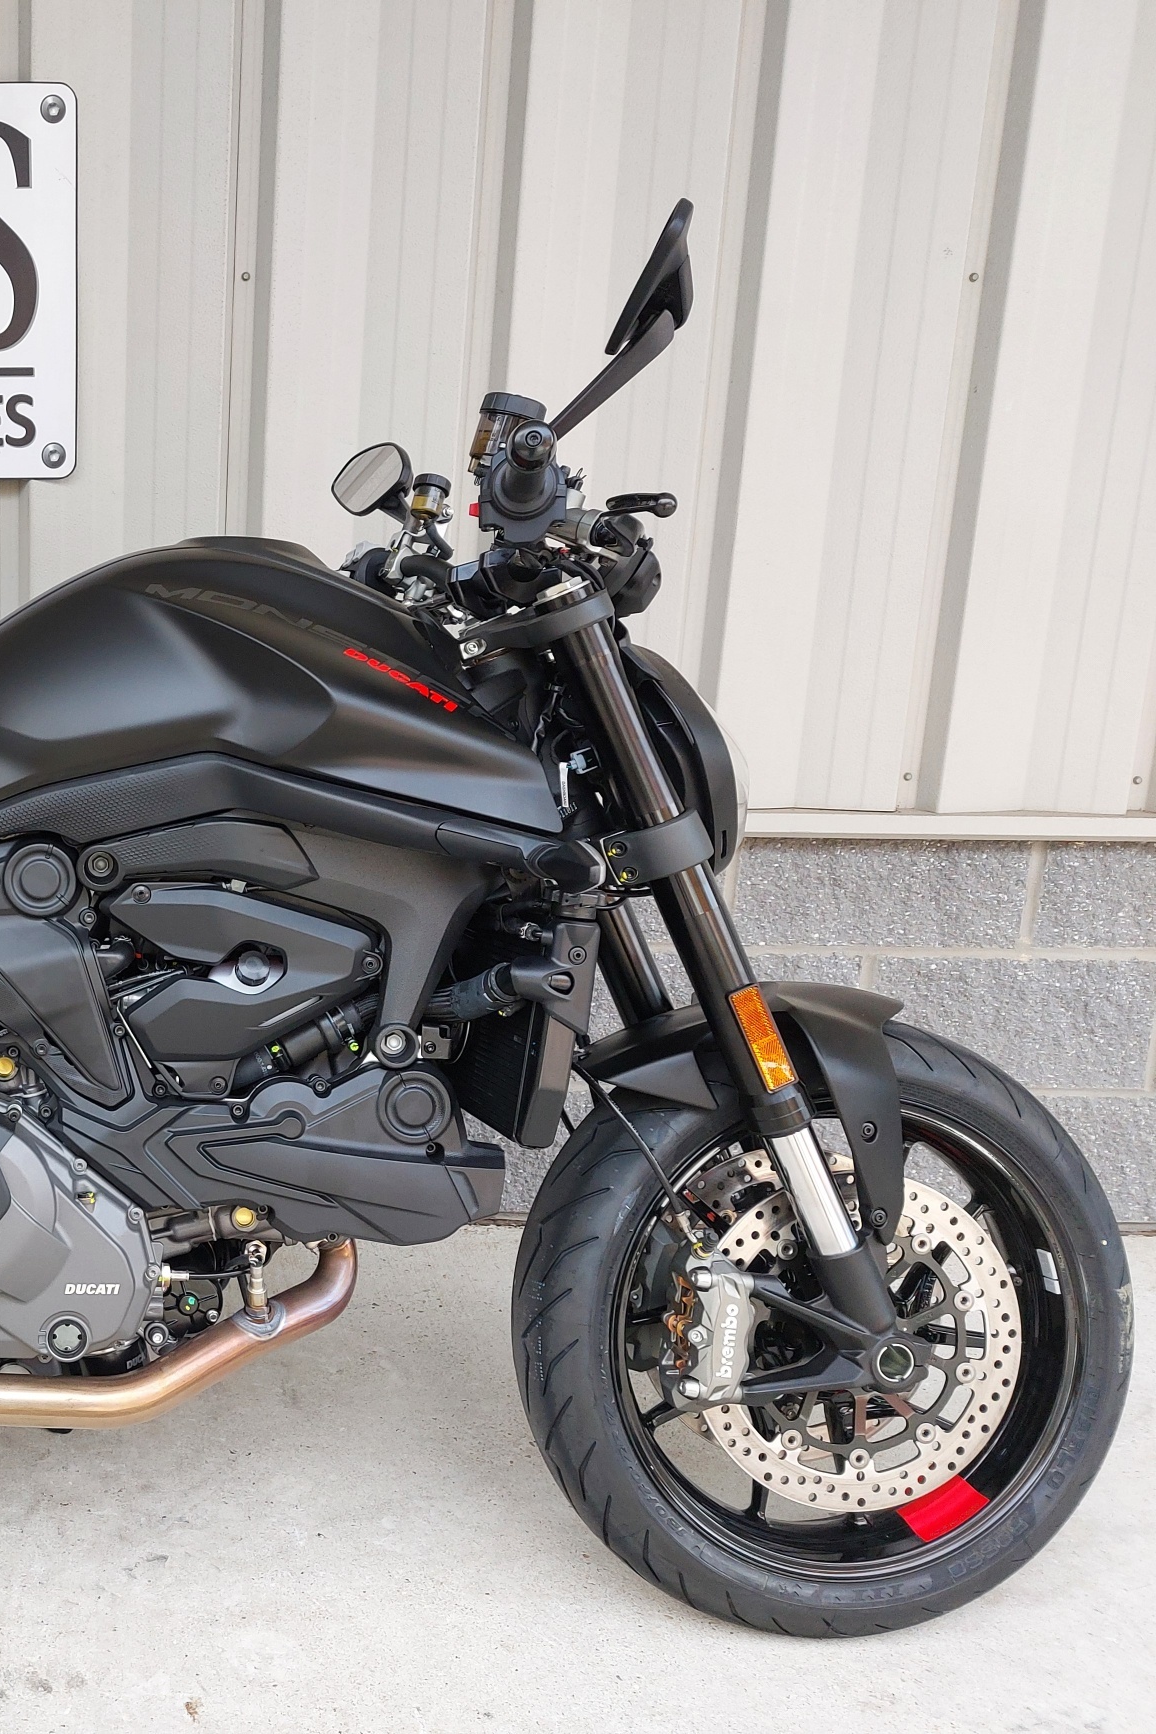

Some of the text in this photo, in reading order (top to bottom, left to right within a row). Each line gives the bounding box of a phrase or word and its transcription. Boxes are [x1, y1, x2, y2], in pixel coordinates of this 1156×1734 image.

[342, 647, 459, 713] DUCATI
[64, 1283, 121, 1295] DUCATI
[126, 1353, 146, 1370] DUC
[715, 1303, 740, 1379] brembo
